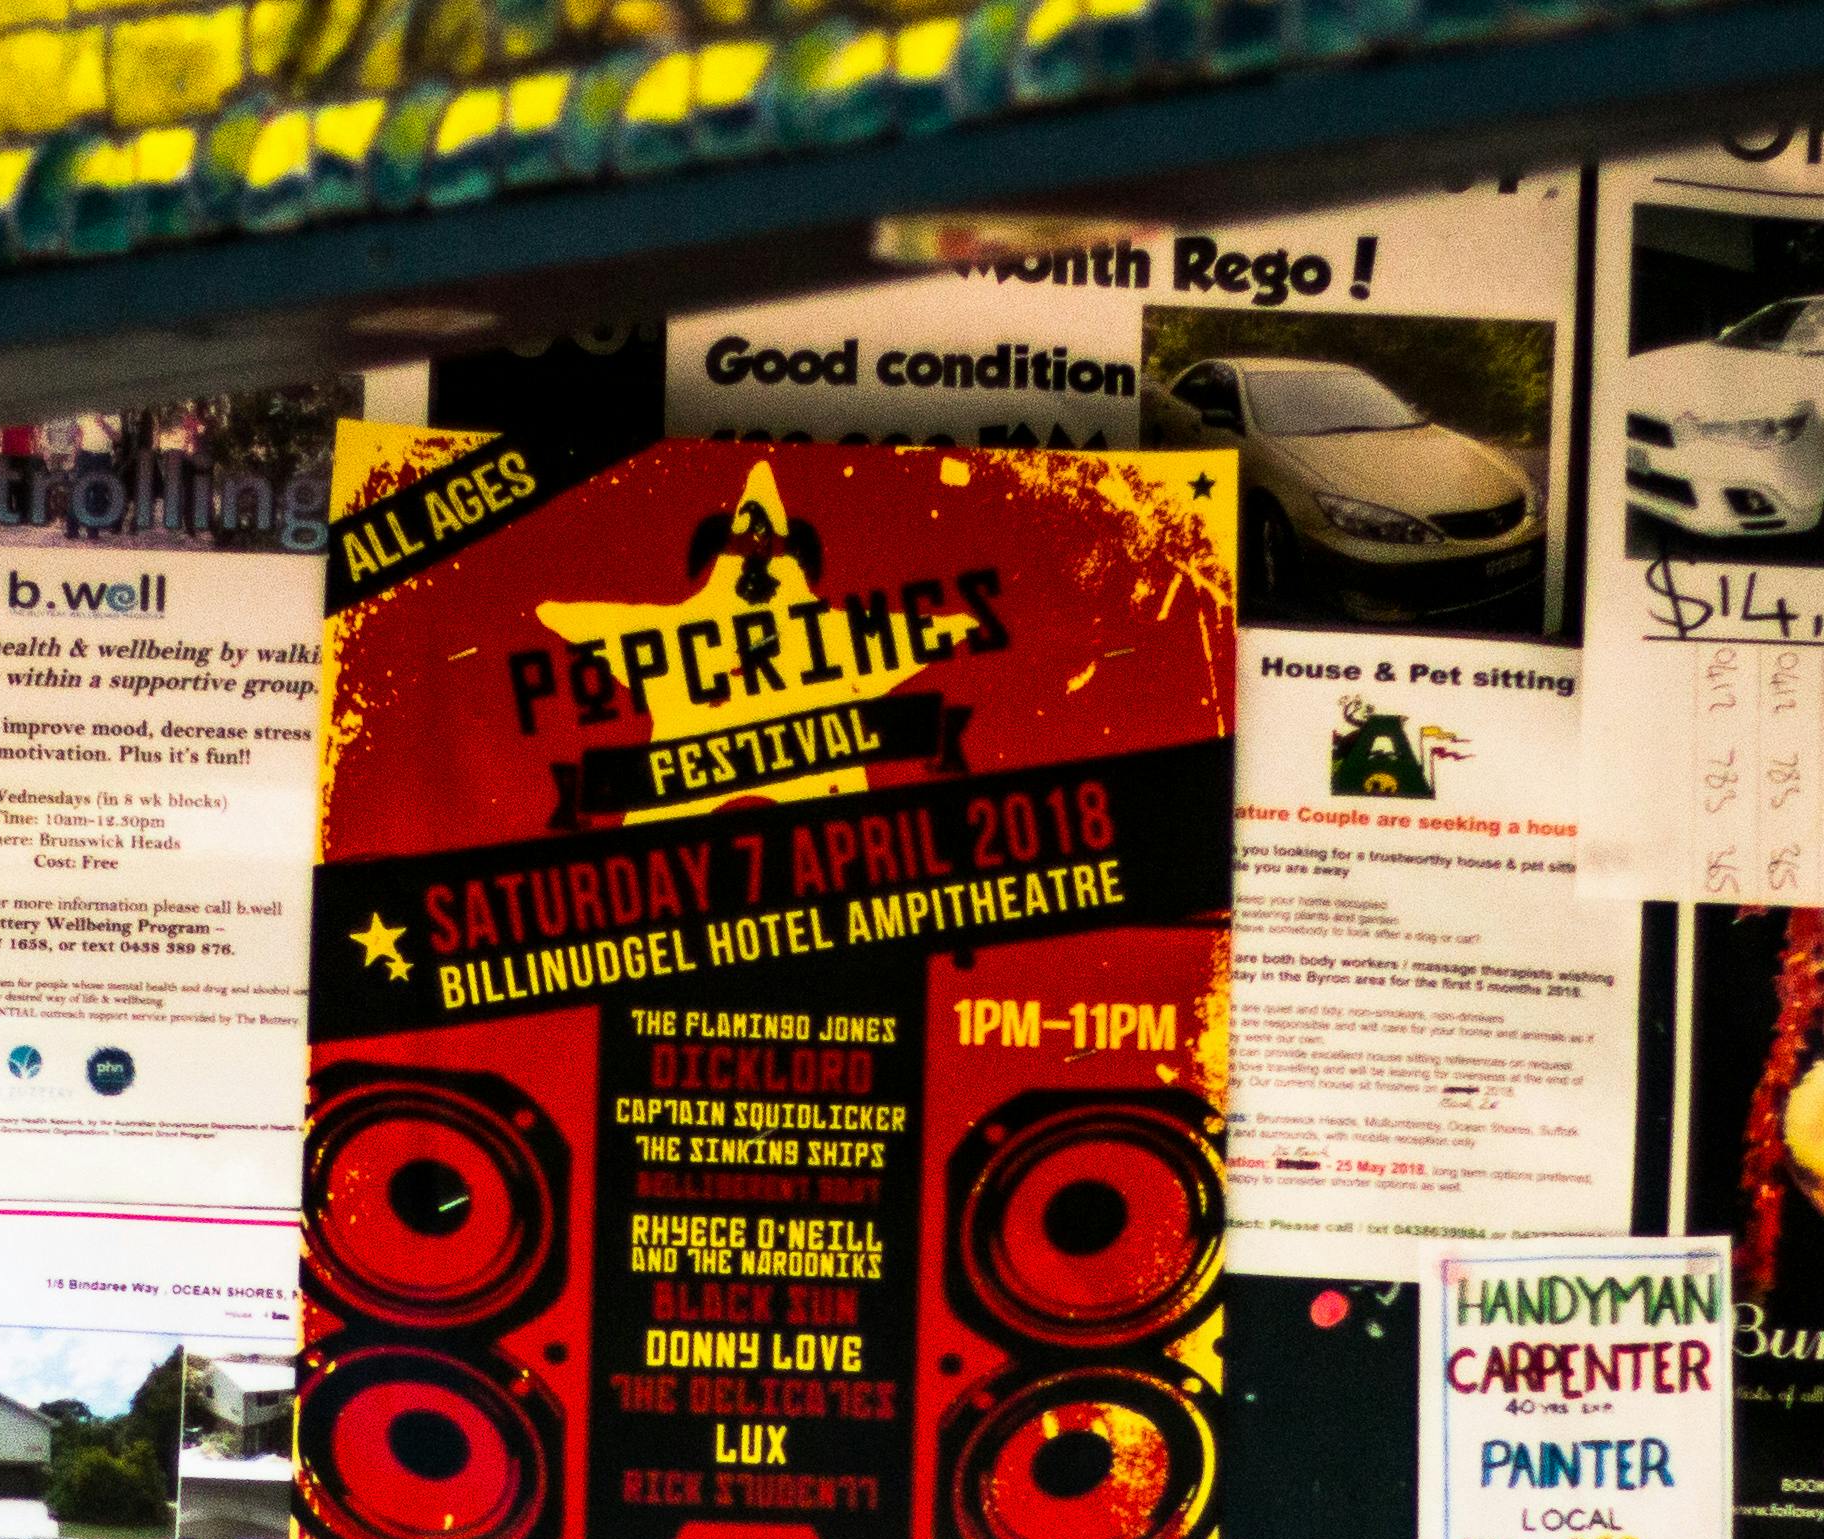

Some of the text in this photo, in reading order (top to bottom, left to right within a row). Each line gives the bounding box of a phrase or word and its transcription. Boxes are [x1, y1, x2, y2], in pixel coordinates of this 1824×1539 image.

[1173, 236, 1332, 306] Rego
[705, 336, 1136, 397] Good condition
[341, 452, 537, 584] ALL AGES
[8, 571, 167, 612] b.well
[70, 638, 90, 659] &
[98, 638, 212, 666] wellbeing
[220, 640, 247, 667] by
[509, 566, 1013, 736] POPCRIMES
[1261, 656, 1576, 696] House & Pet sitting
[648, 707, 881, 797] FESTIVAL
[424, 780, 1116, 956] SATURDAY 7 APRIL 2018
[438, 859, 1125, 1011] BILLINUDGEL HOTEL AMPITHEATRE
[632, 1010, 896, 1042] THE FLAMINGO JONES
[651, 1043, 872, 1093] DICKLORD
[616, 1097, 906, 1132] CAPTAIN SQUIDLICKER
[636, 1135, 885, 1168] THE SINKING SHIPS
[632, 1214, 746, 1248] RHYECE
[652, 1281, 859, 1325] BLACK SUN
[1457, 1274, 1719, 1327] HANDYMAN
[646, 1330, 862, 1372] DONNY LOVE
[1446, 1340, 1712, 1399] CARPENTER
[716, 1424, 787, 1465] LUX
[1480, 1438, 1675, 1491] PAINTER
[1522, 1507, 1623, 1533] LOCAL
